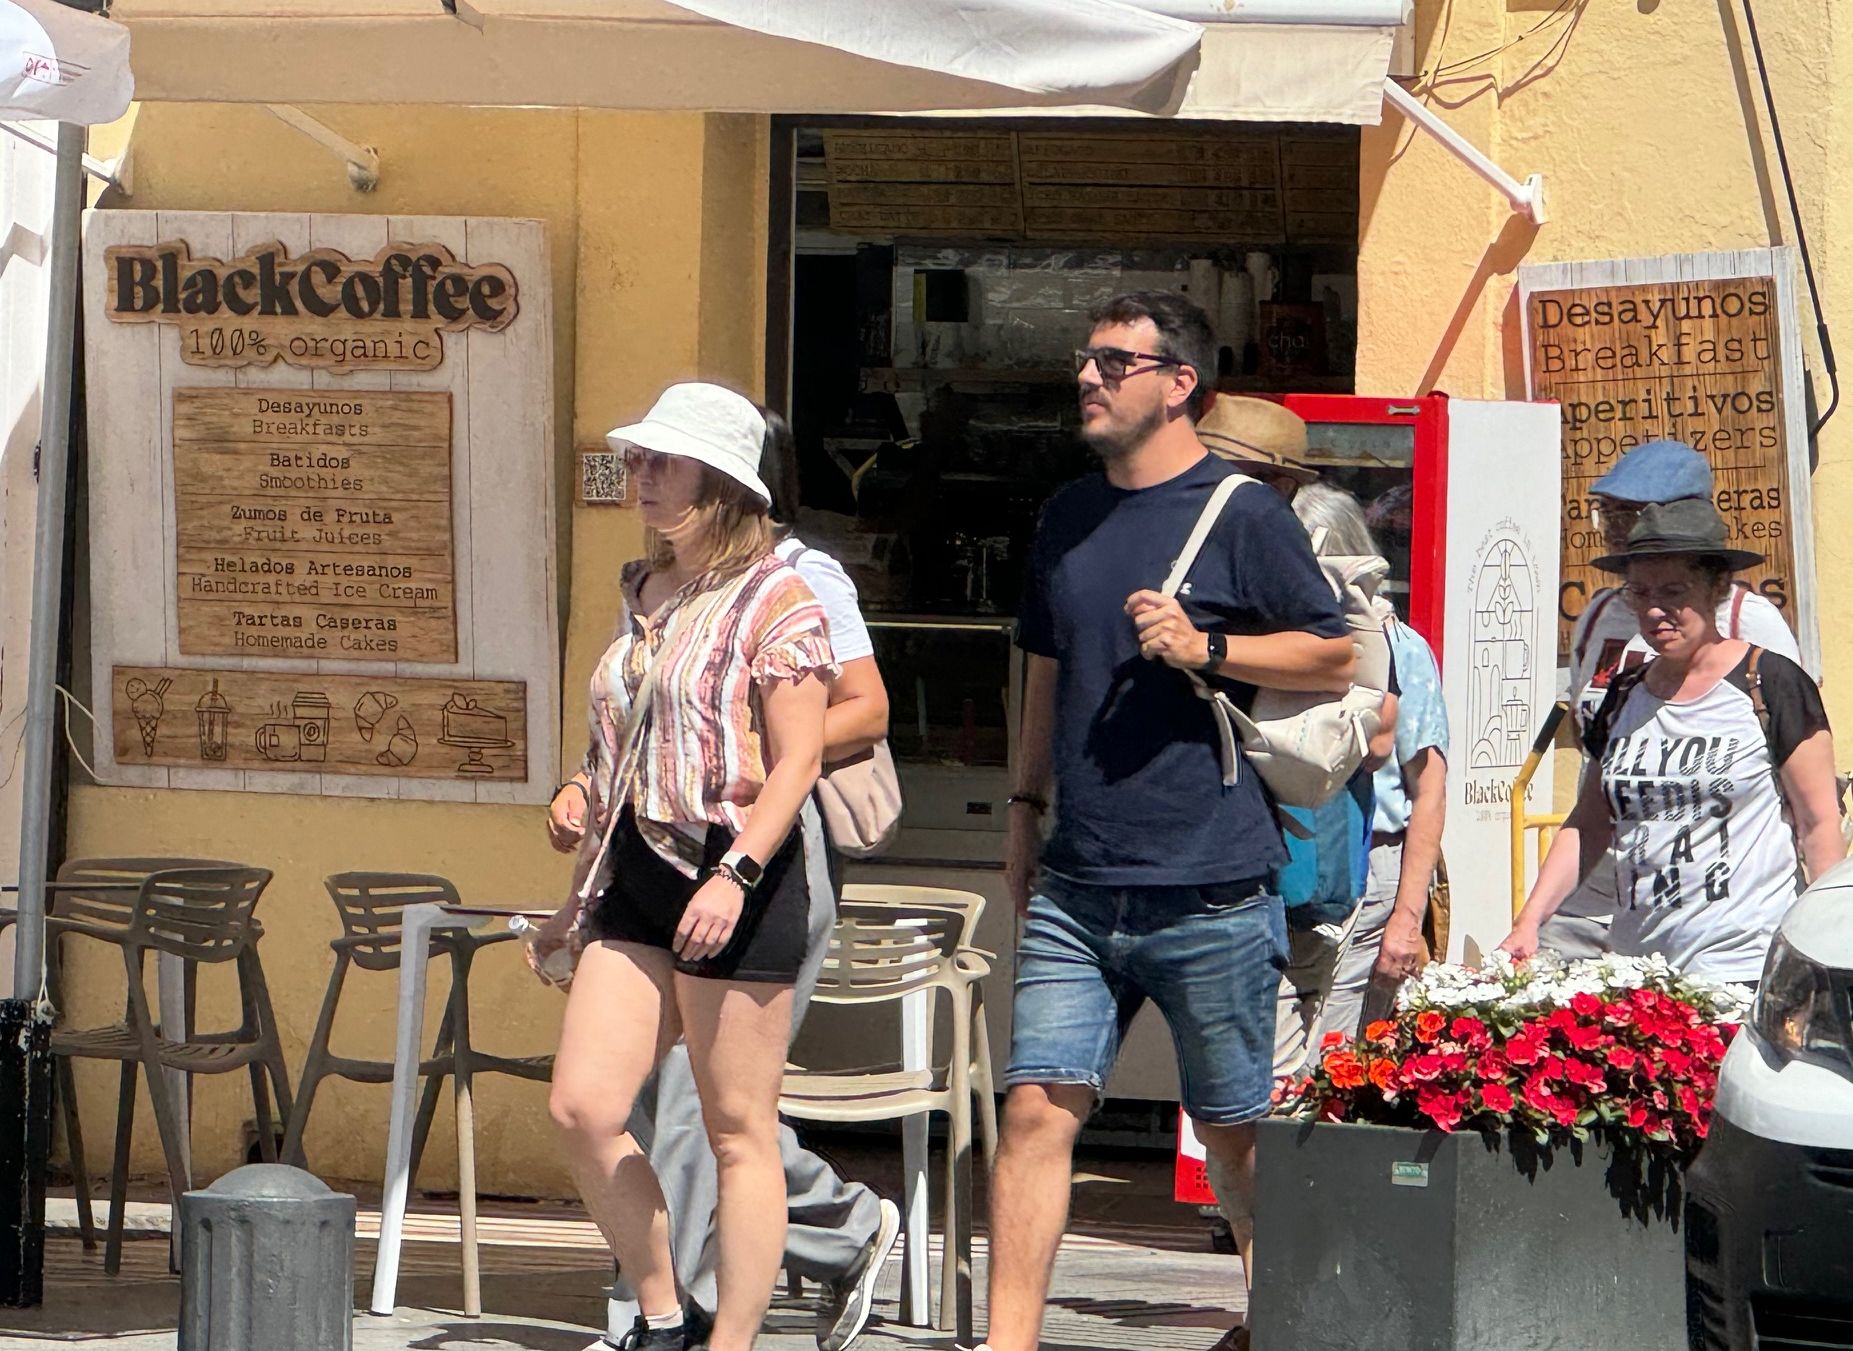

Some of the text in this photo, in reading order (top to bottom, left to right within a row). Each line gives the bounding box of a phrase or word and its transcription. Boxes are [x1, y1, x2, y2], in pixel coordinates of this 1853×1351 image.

[114, 251, 507, 320] BlackCoffee
[1537, 290, 1769, 330] Desayunos
[190, 328, 431, 362] 100% organic
[1542, 329, 1771, 374] Breakfast
[258, 398, 363, 418] Desayunos
[253, 419, 369, 437] Breakfasts
[270, 453, 350, 470] Batidos
[259, 473, 363, 491] Smoothies
[231, 505, 394, 525] Zumos de Fruta
[243, 526, 382, 545] Fruit Juices
[214, 557, 413, 578] Helados Artesanos
[192, 577, 438, 601] Handcrafted Ice Cream
[233, 611, 398, 631] Tartas Caseras
[234, 631, 399, 652] Homemade Cakes
